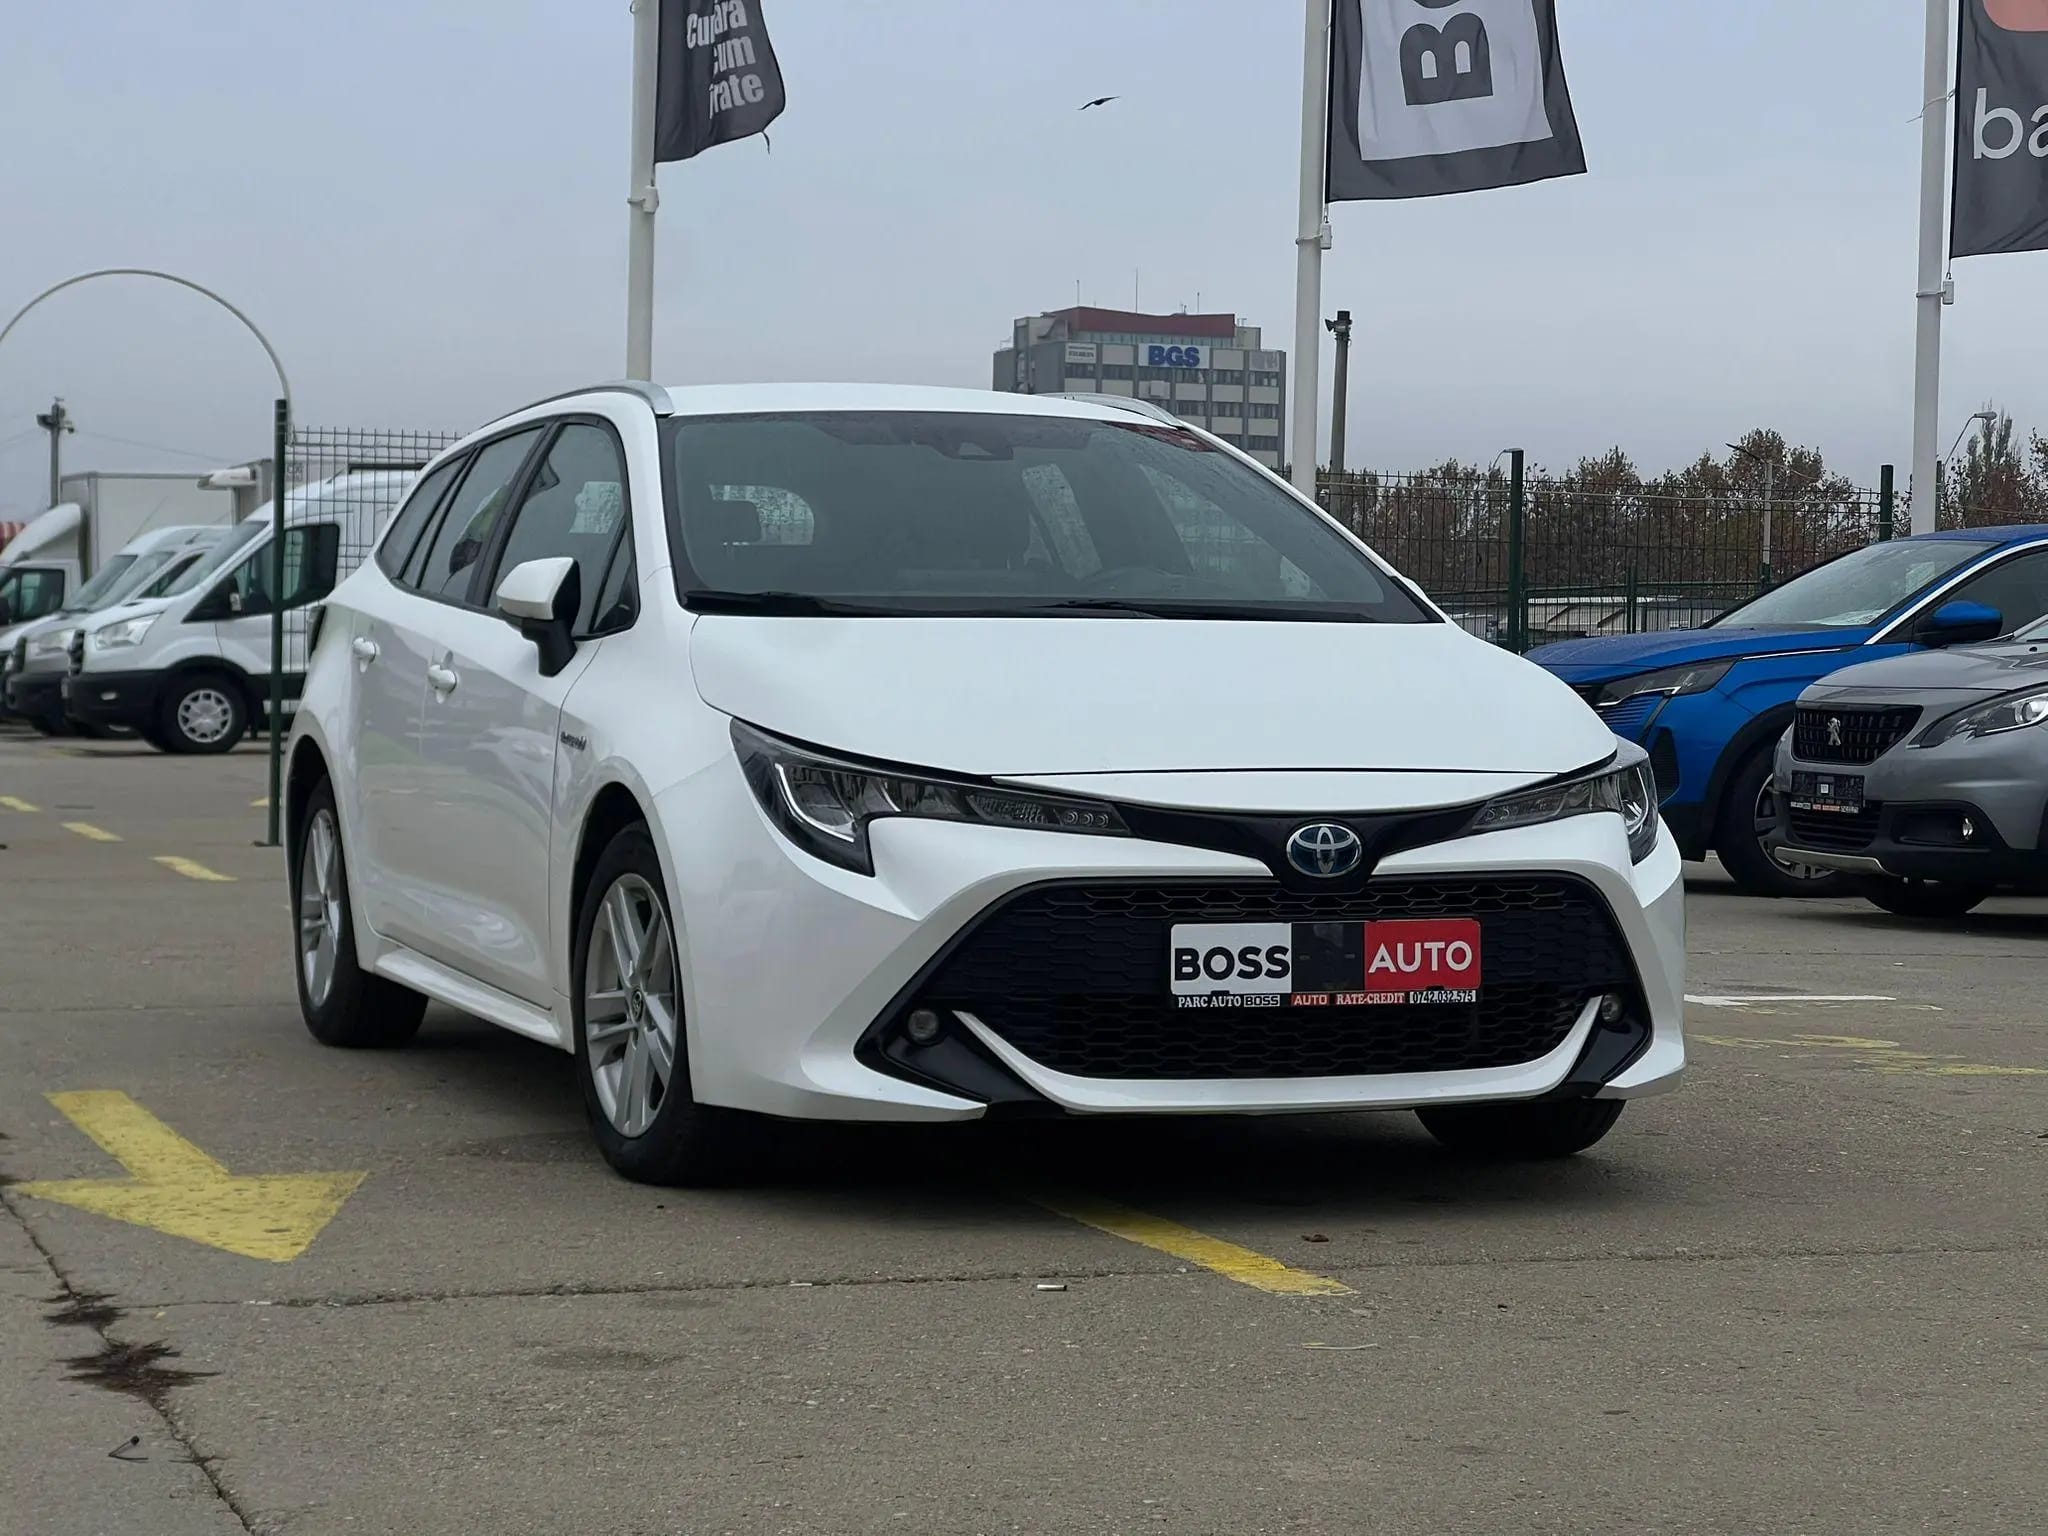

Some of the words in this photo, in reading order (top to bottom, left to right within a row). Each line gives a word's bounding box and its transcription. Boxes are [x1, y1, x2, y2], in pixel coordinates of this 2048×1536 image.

[1148, 345, 1201, 368] BGS
[1174, 946, 1291, 981] BOSS
[1368, 941, 1473, 973] AUTO
[1178, 996, 1208, 1008] PARC
[1210, 995, 1242, 1007] AUTO
[1244, 995, 1280, 1007] BOSS
[1294, 994, 1328, 1005] AUTO
